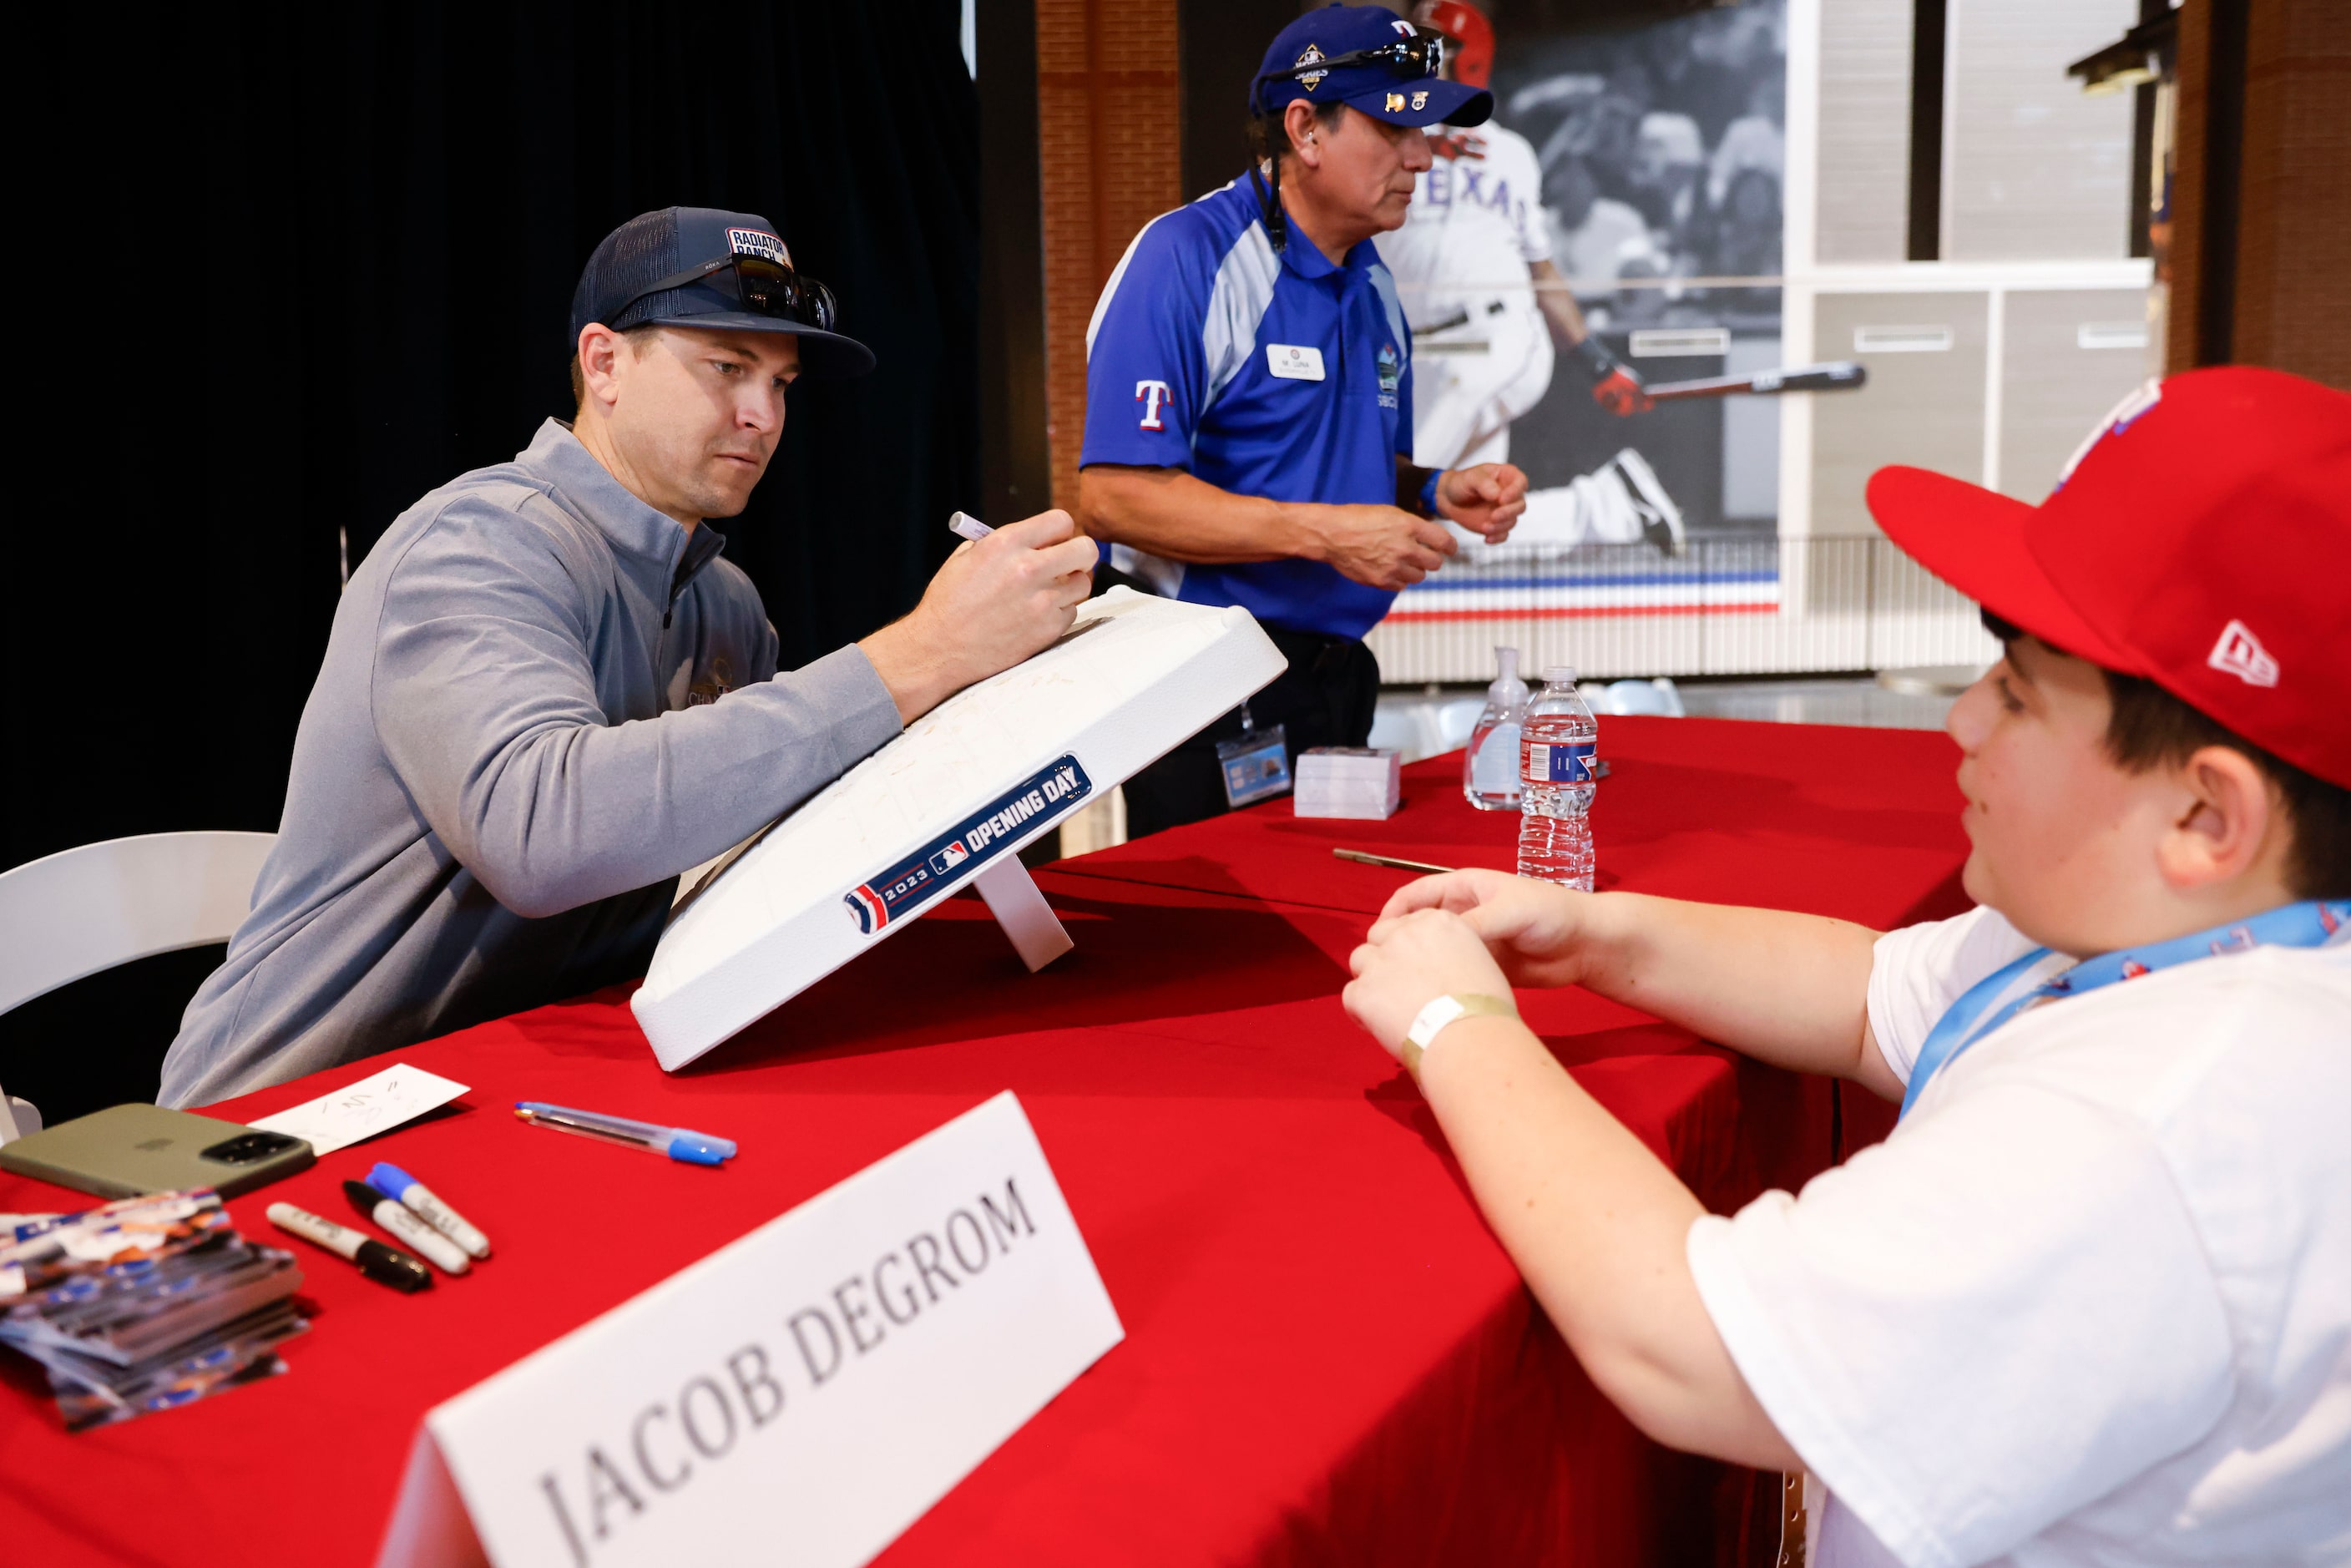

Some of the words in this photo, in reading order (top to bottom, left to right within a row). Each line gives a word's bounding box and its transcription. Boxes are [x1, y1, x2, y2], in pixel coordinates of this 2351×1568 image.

[733, 231, 785, 256] RADIATOR
[1135, 379, 1174, 432] T
[885, 869, 928, 902] 2023
[966, 792, 1045, 853] OPENING
[1041, 766, 1079, 803] DAY
[538, 1342, 787, 1568] JACOB
[785, 1176, 1039, 1389] DEGROM
